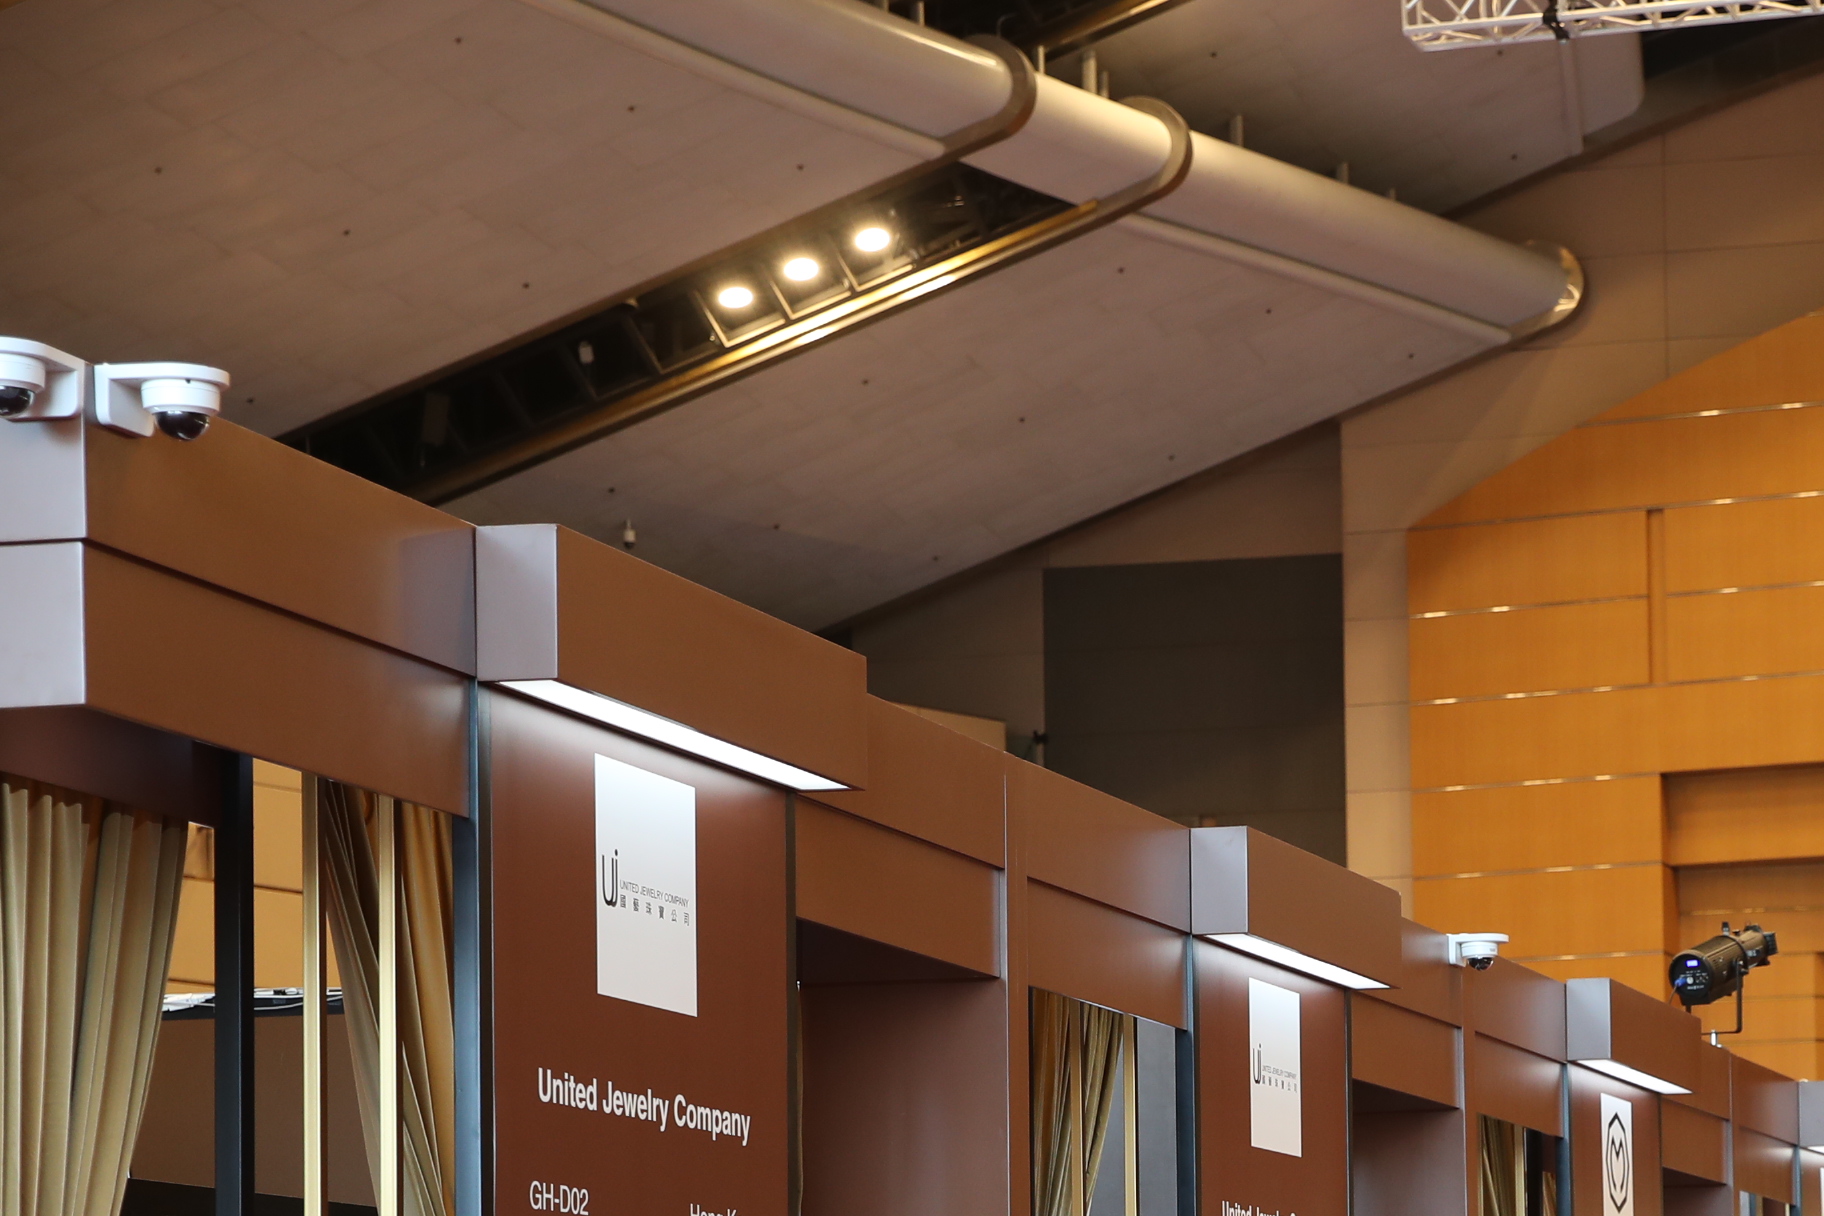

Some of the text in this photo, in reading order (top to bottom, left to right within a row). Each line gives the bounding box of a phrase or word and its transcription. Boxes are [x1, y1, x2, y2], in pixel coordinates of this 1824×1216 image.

[620, 880, 689, 908] UNITED JEWELRY COMPANY
[538, 1067, 751, 1147] United Jewelry Company
[529, 1180, 589, 1216] GH-D02
